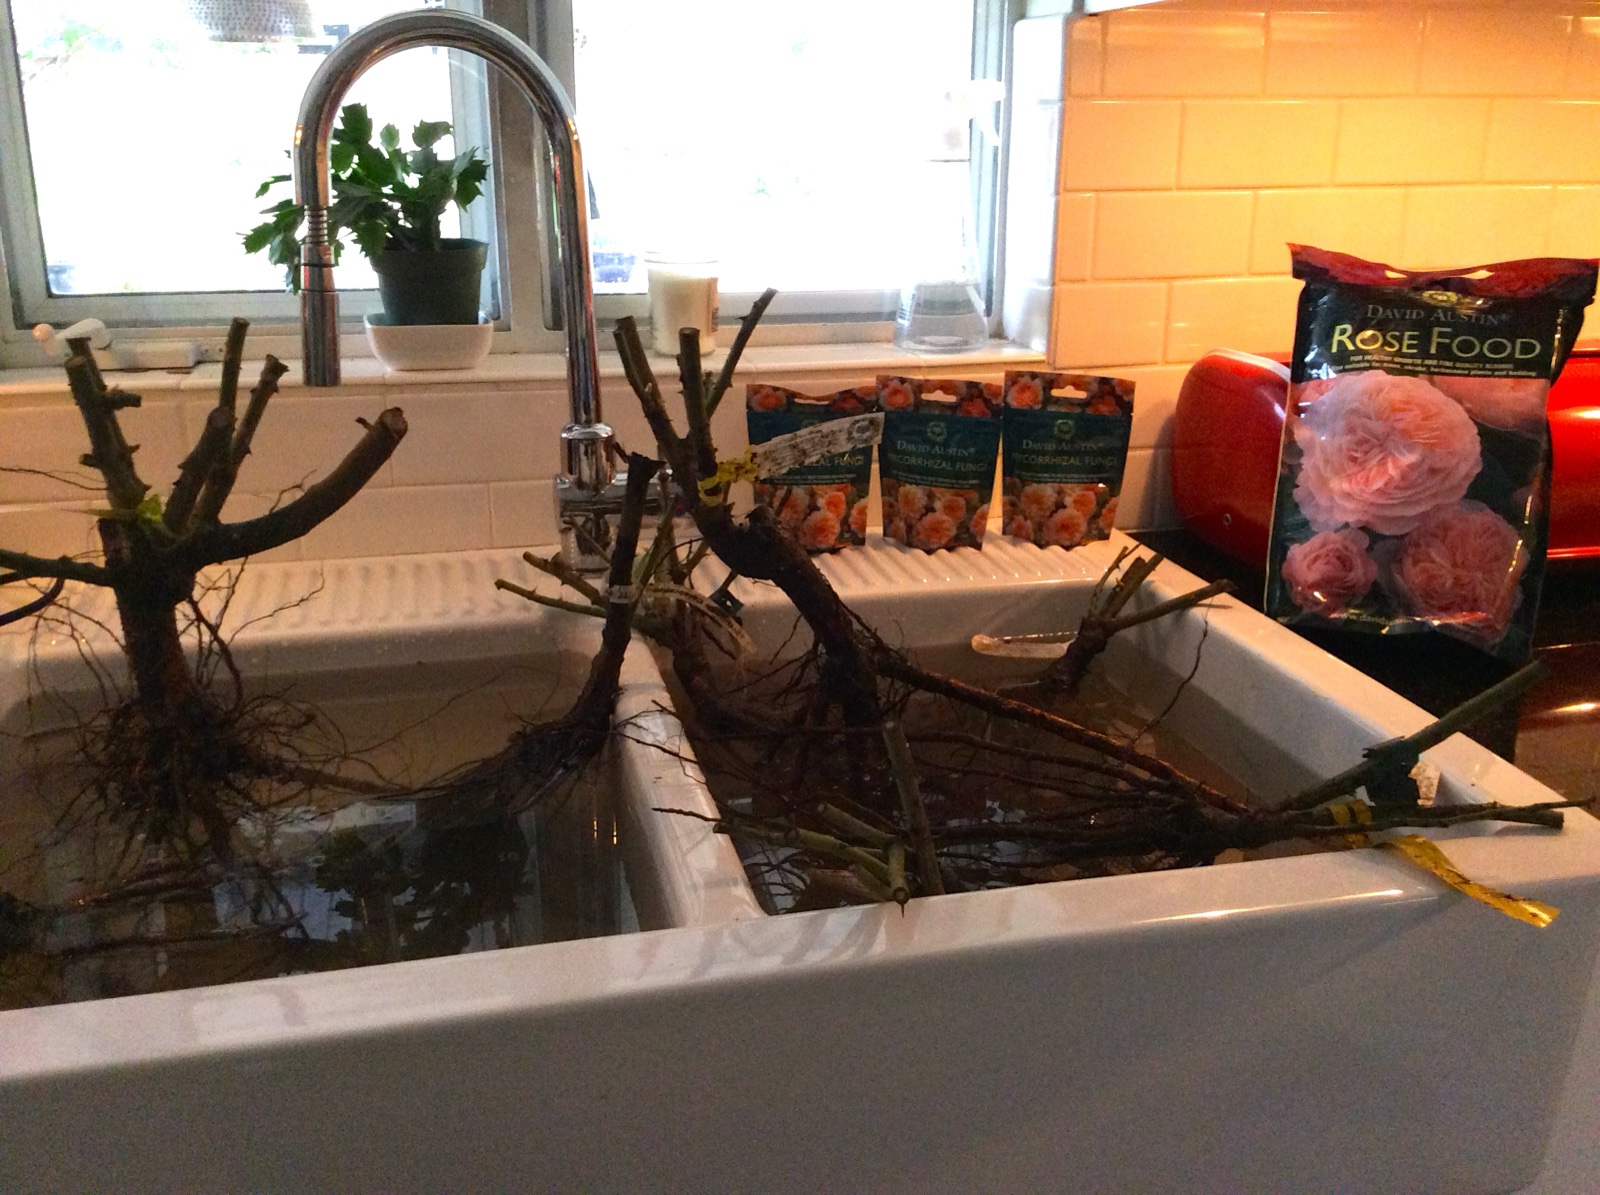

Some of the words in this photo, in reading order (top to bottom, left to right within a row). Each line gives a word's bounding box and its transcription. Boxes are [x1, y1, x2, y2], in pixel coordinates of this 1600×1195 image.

[1366, 304, 1425, 320] DAVID
[1331, 323, 1421, 354] ROSE
[1429, 326, 1542, 360] FOOD
[896, 440, 930, 454] DAVID
